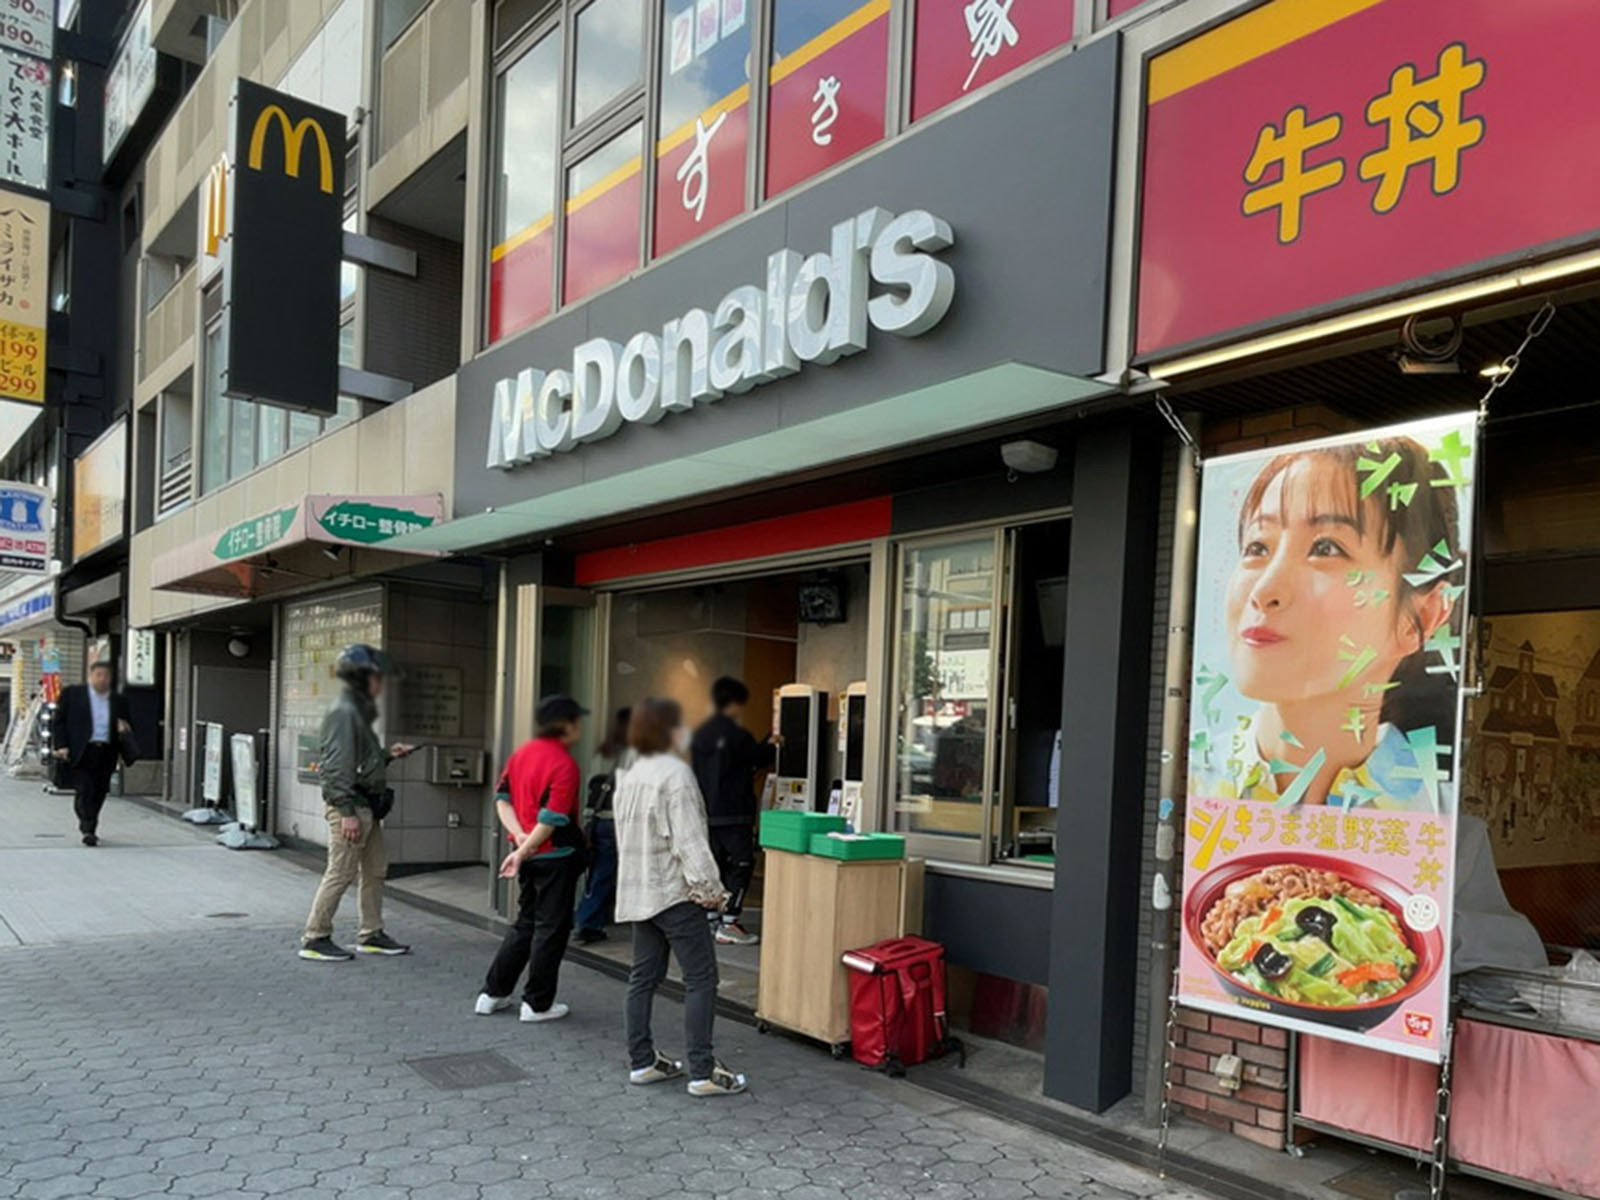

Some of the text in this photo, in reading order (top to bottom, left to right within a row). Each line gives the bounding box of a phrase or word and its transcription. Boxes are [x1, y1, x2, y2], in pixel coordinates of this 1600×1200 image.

[4, 60, 26, 177] てんぐ大ホール
[1241, 41, 1487, 245] 牛丼
[0, 373, 37, 395] 299
[487, 206, 955, 469] McDonald's
